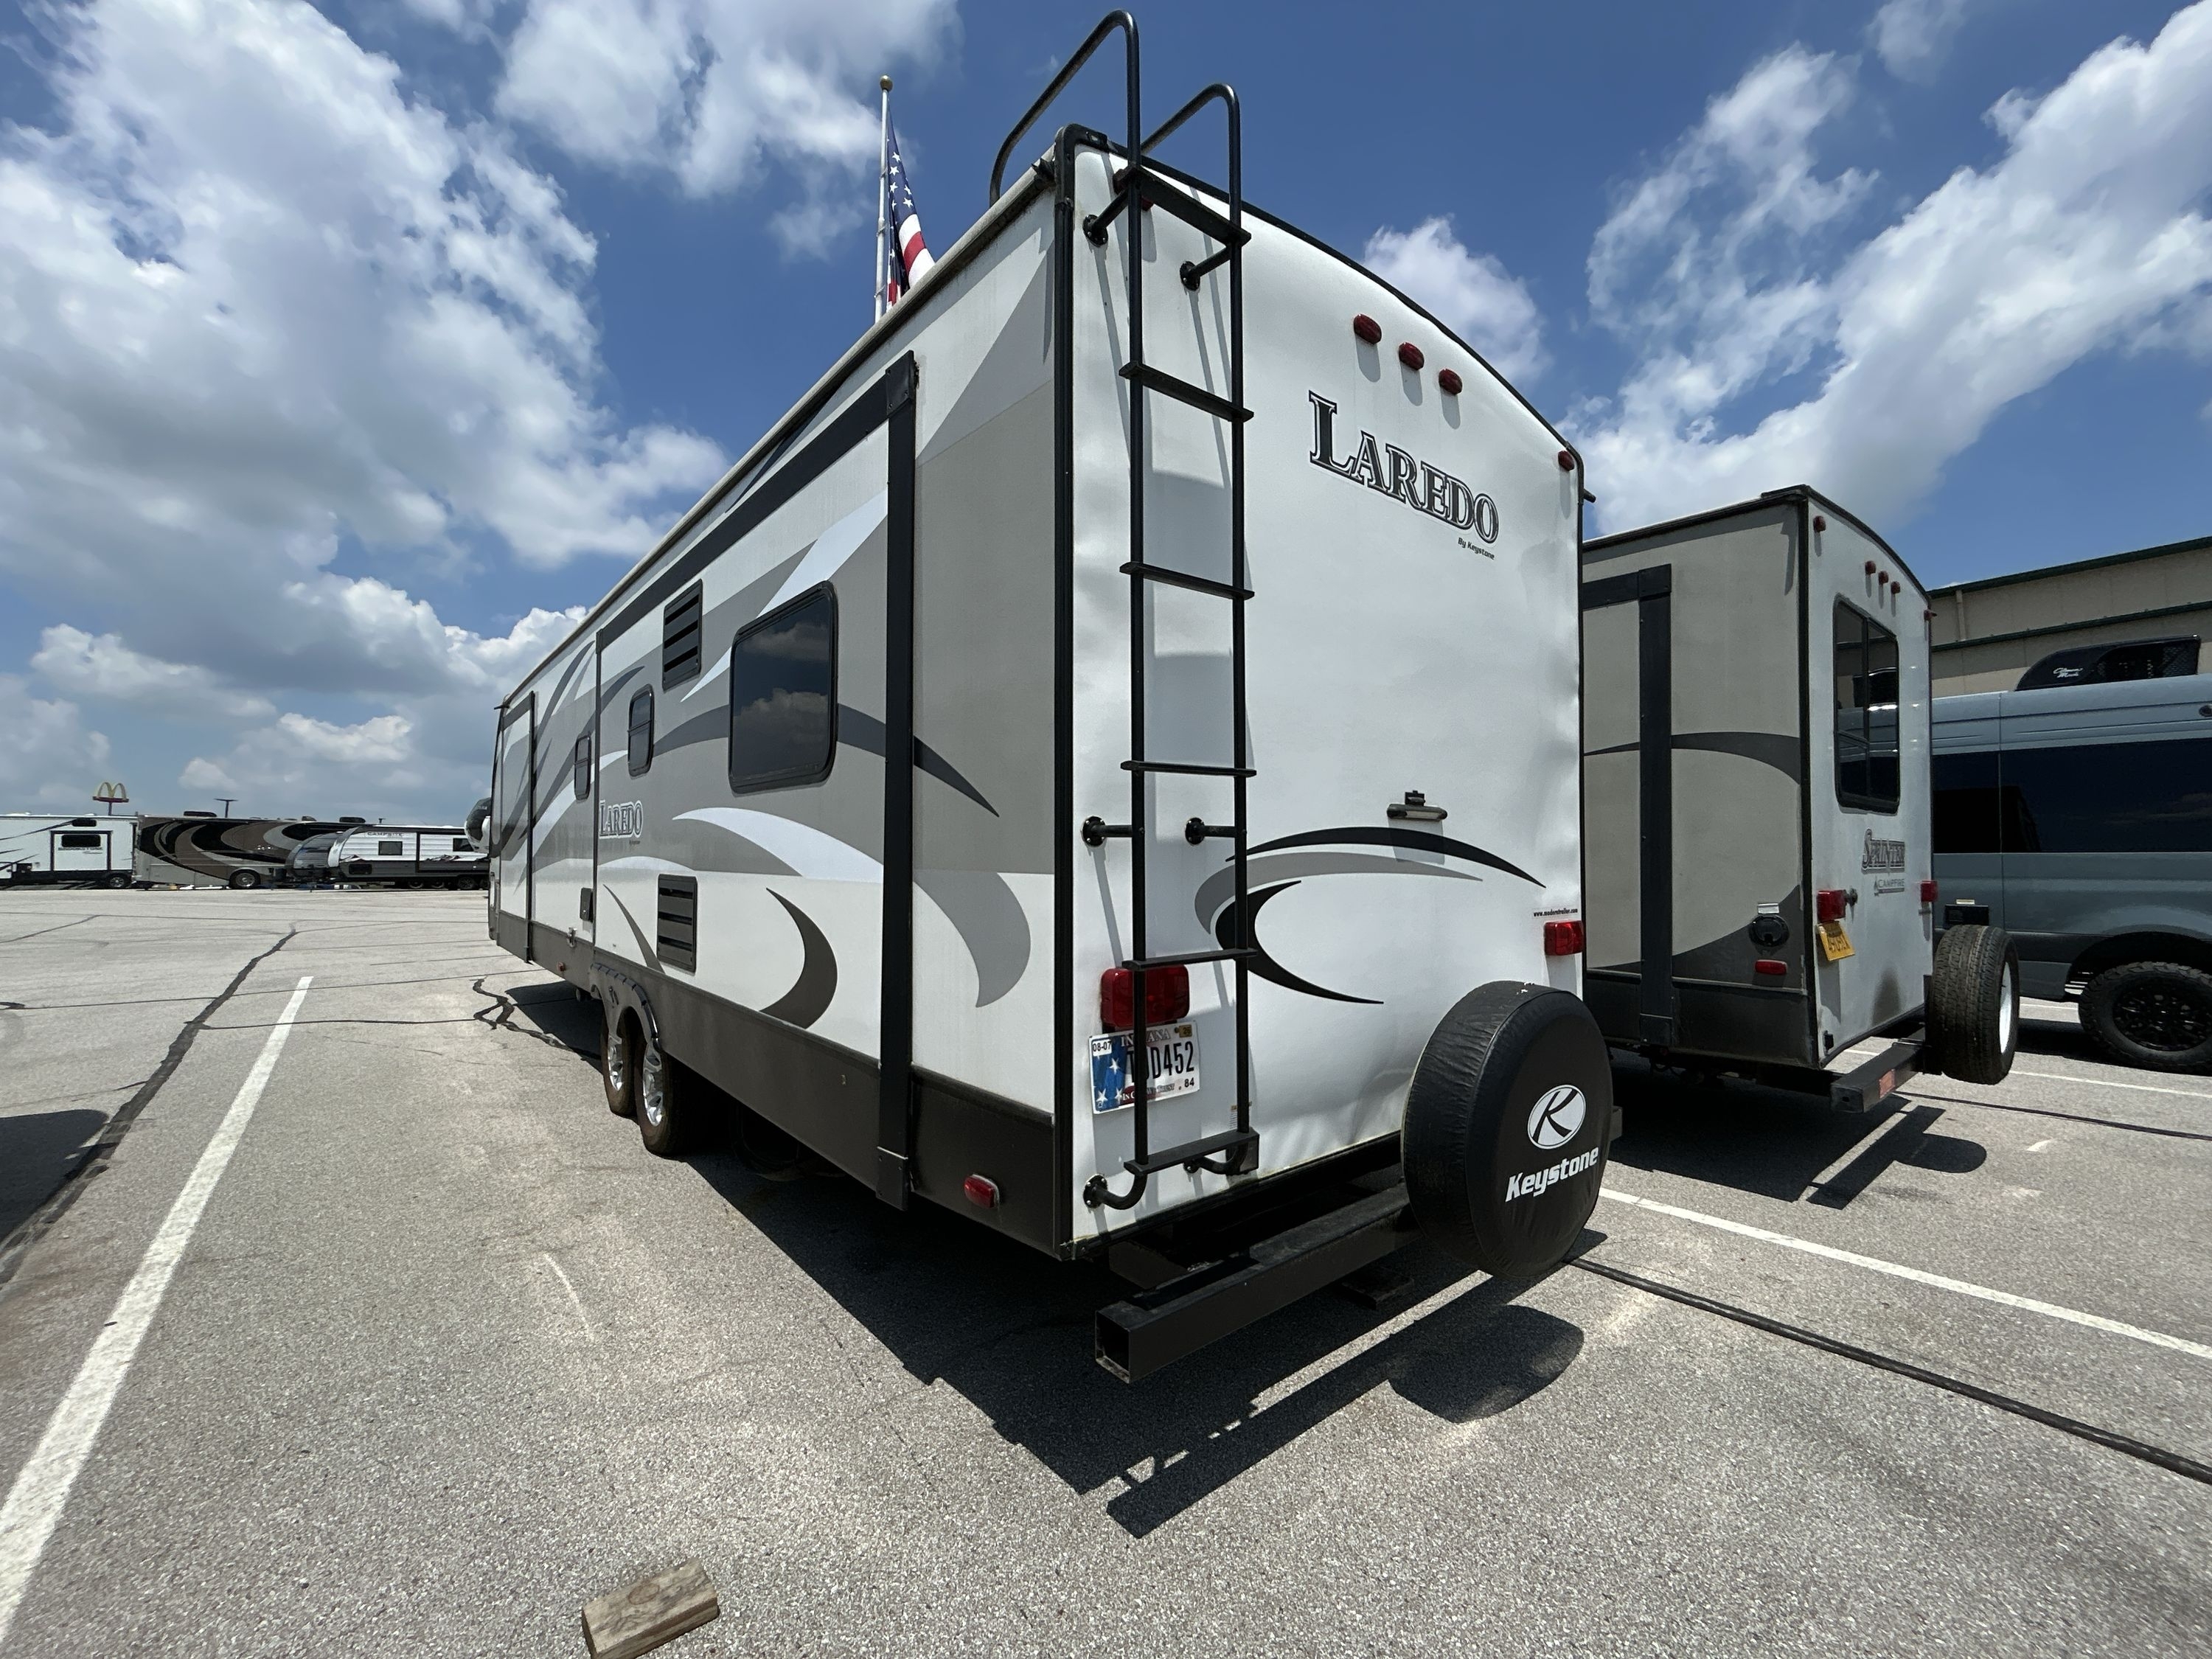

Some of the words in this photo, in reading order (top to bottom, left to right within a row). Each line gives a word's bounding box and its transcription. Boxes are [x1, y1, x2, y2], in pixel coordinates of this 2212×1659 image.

[1309, 390, 1500, 544] LAREDO
[1458, 537, 1467, 549] By
[1467, 541, 1495, 560] Keystone
[599, 801, 643, 838] LAREDO
[1093, 1041, 1112, 1052] 08-07
[1120, 1028, 1172, 1047] INANA
[1127, 1041, 1194, 1083] TD452
[1184, 1077, 1194, 1088] 84
[1505, 1147, 1599, 1203] Keystone
